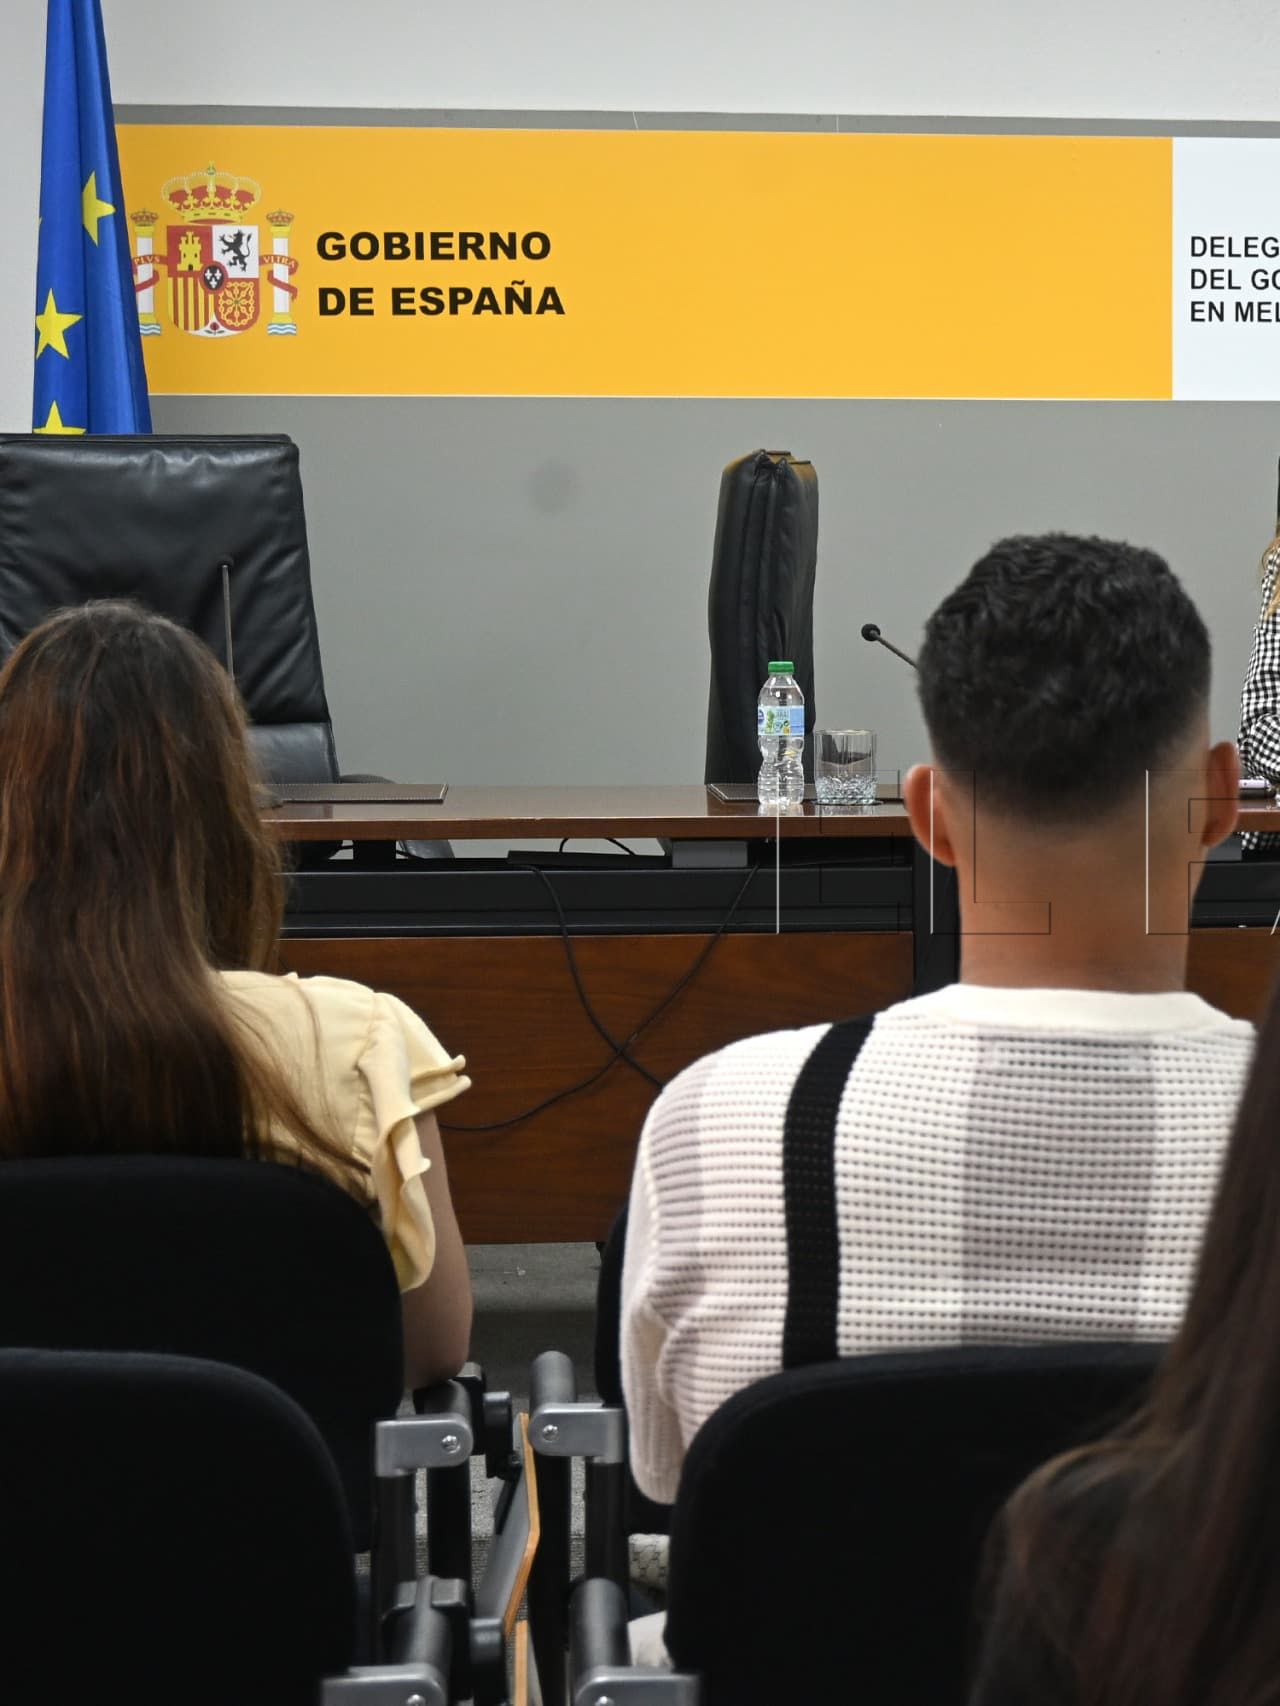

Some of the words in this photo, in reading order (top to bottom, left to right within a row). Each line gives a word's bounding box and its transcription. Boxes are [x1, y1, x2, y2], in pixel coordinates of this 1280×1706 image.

[316, 231, 552, 261] GOBIERNO
[1190, 268, 1242, 290] DEL
[318, 287, 375, 316] DE
[391, 279, 566, 316] ESPAÑA
[1190, 301, 1225, 323] EN
